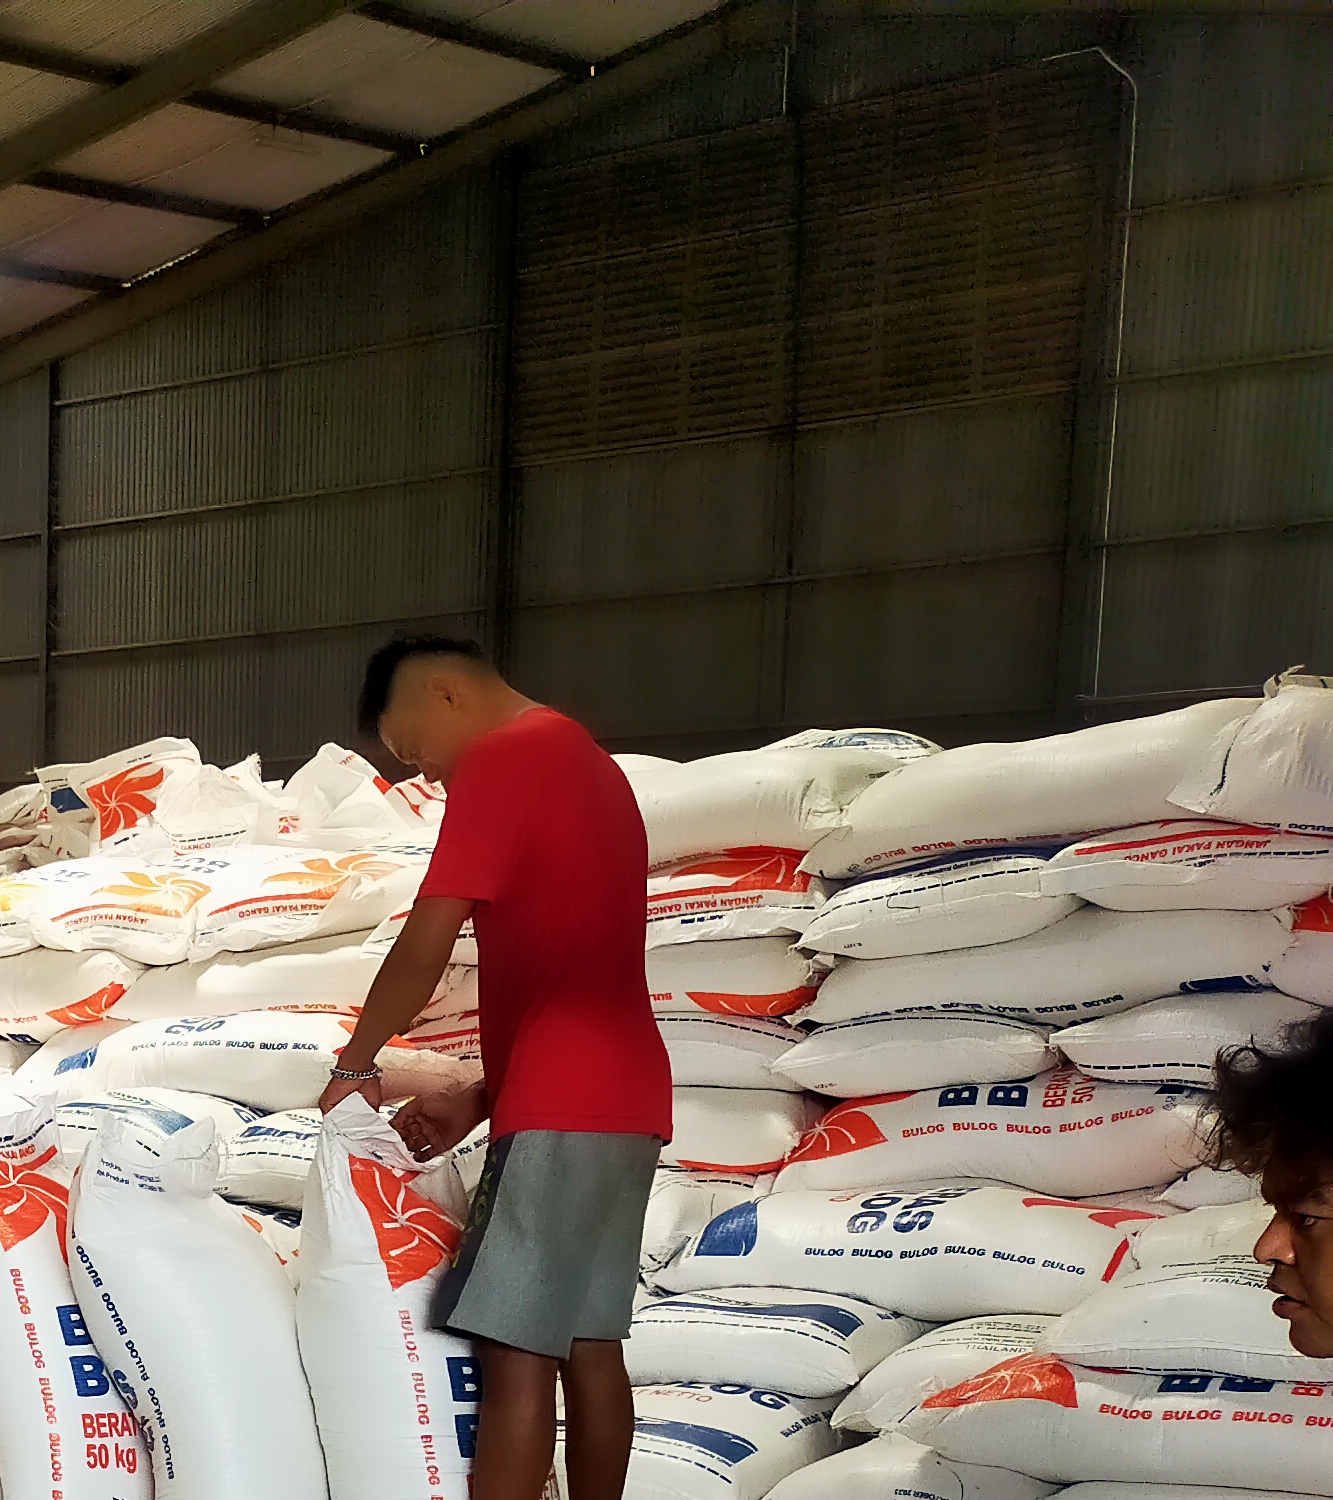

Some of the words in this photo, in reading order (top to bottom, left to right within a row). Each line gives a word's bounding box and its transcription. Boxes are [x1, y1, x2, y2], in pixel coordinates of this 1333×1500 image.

[1172, 842, 1212, 860] PAKAI
[1212, 838, 1271, 851] JANGAN
[685, 900, 718, 910] PAKAI
[225, 1040, 255, 1050] BULOG
[259, 1042, 289, 1050] BULOG
[902, 1123, 946, 1139] BULOG
[952, 1122, 998, 1132] BULOG
[1006, 1123, 1052, 1136] BULOG
[1059, 1117, 1104, 1134] BULOG
[1110, 1106, 1155, 1124] BULOG
[76, 1245, 104, 1288] BULOG
[805, 1247, 845, 1257] BULOG
[851, 1248, 893, 1259] BULOG
[899, 1246, 939, 1260] BULOG
[944, 1245, 986, 1257] BULOG
[992, 1250, 1036, 1266] BULOG
[1041, 1259, 1086, 1276] BULOG
[10, 1268, 32, 1316] BULOG
[101, 1292, 128, 1336] BULOG
[24, 1322, 46, 1369] BULOG
[397, 1309, 420, 1364] BULOG
[124, 1339, 150, 1382] BULOG
[38, 1377, 58, 1425] BULOG
[409, 1372, 432, 1426] BULOG
[1098, 1403, 1153, 1420] BULOG
[1161, 1409, 1222, 1421] BULOG
[1232, 1411, 1294, 1424] BULOG
[48, 1432, 63, 1482] BULOG
[86, 1443, 110, 1469] 50
[115, 1443, 138, 1474] kg
[161, 1434, 175, 1480] BULOG
[420, 1434, 441, 1486] BULOG
